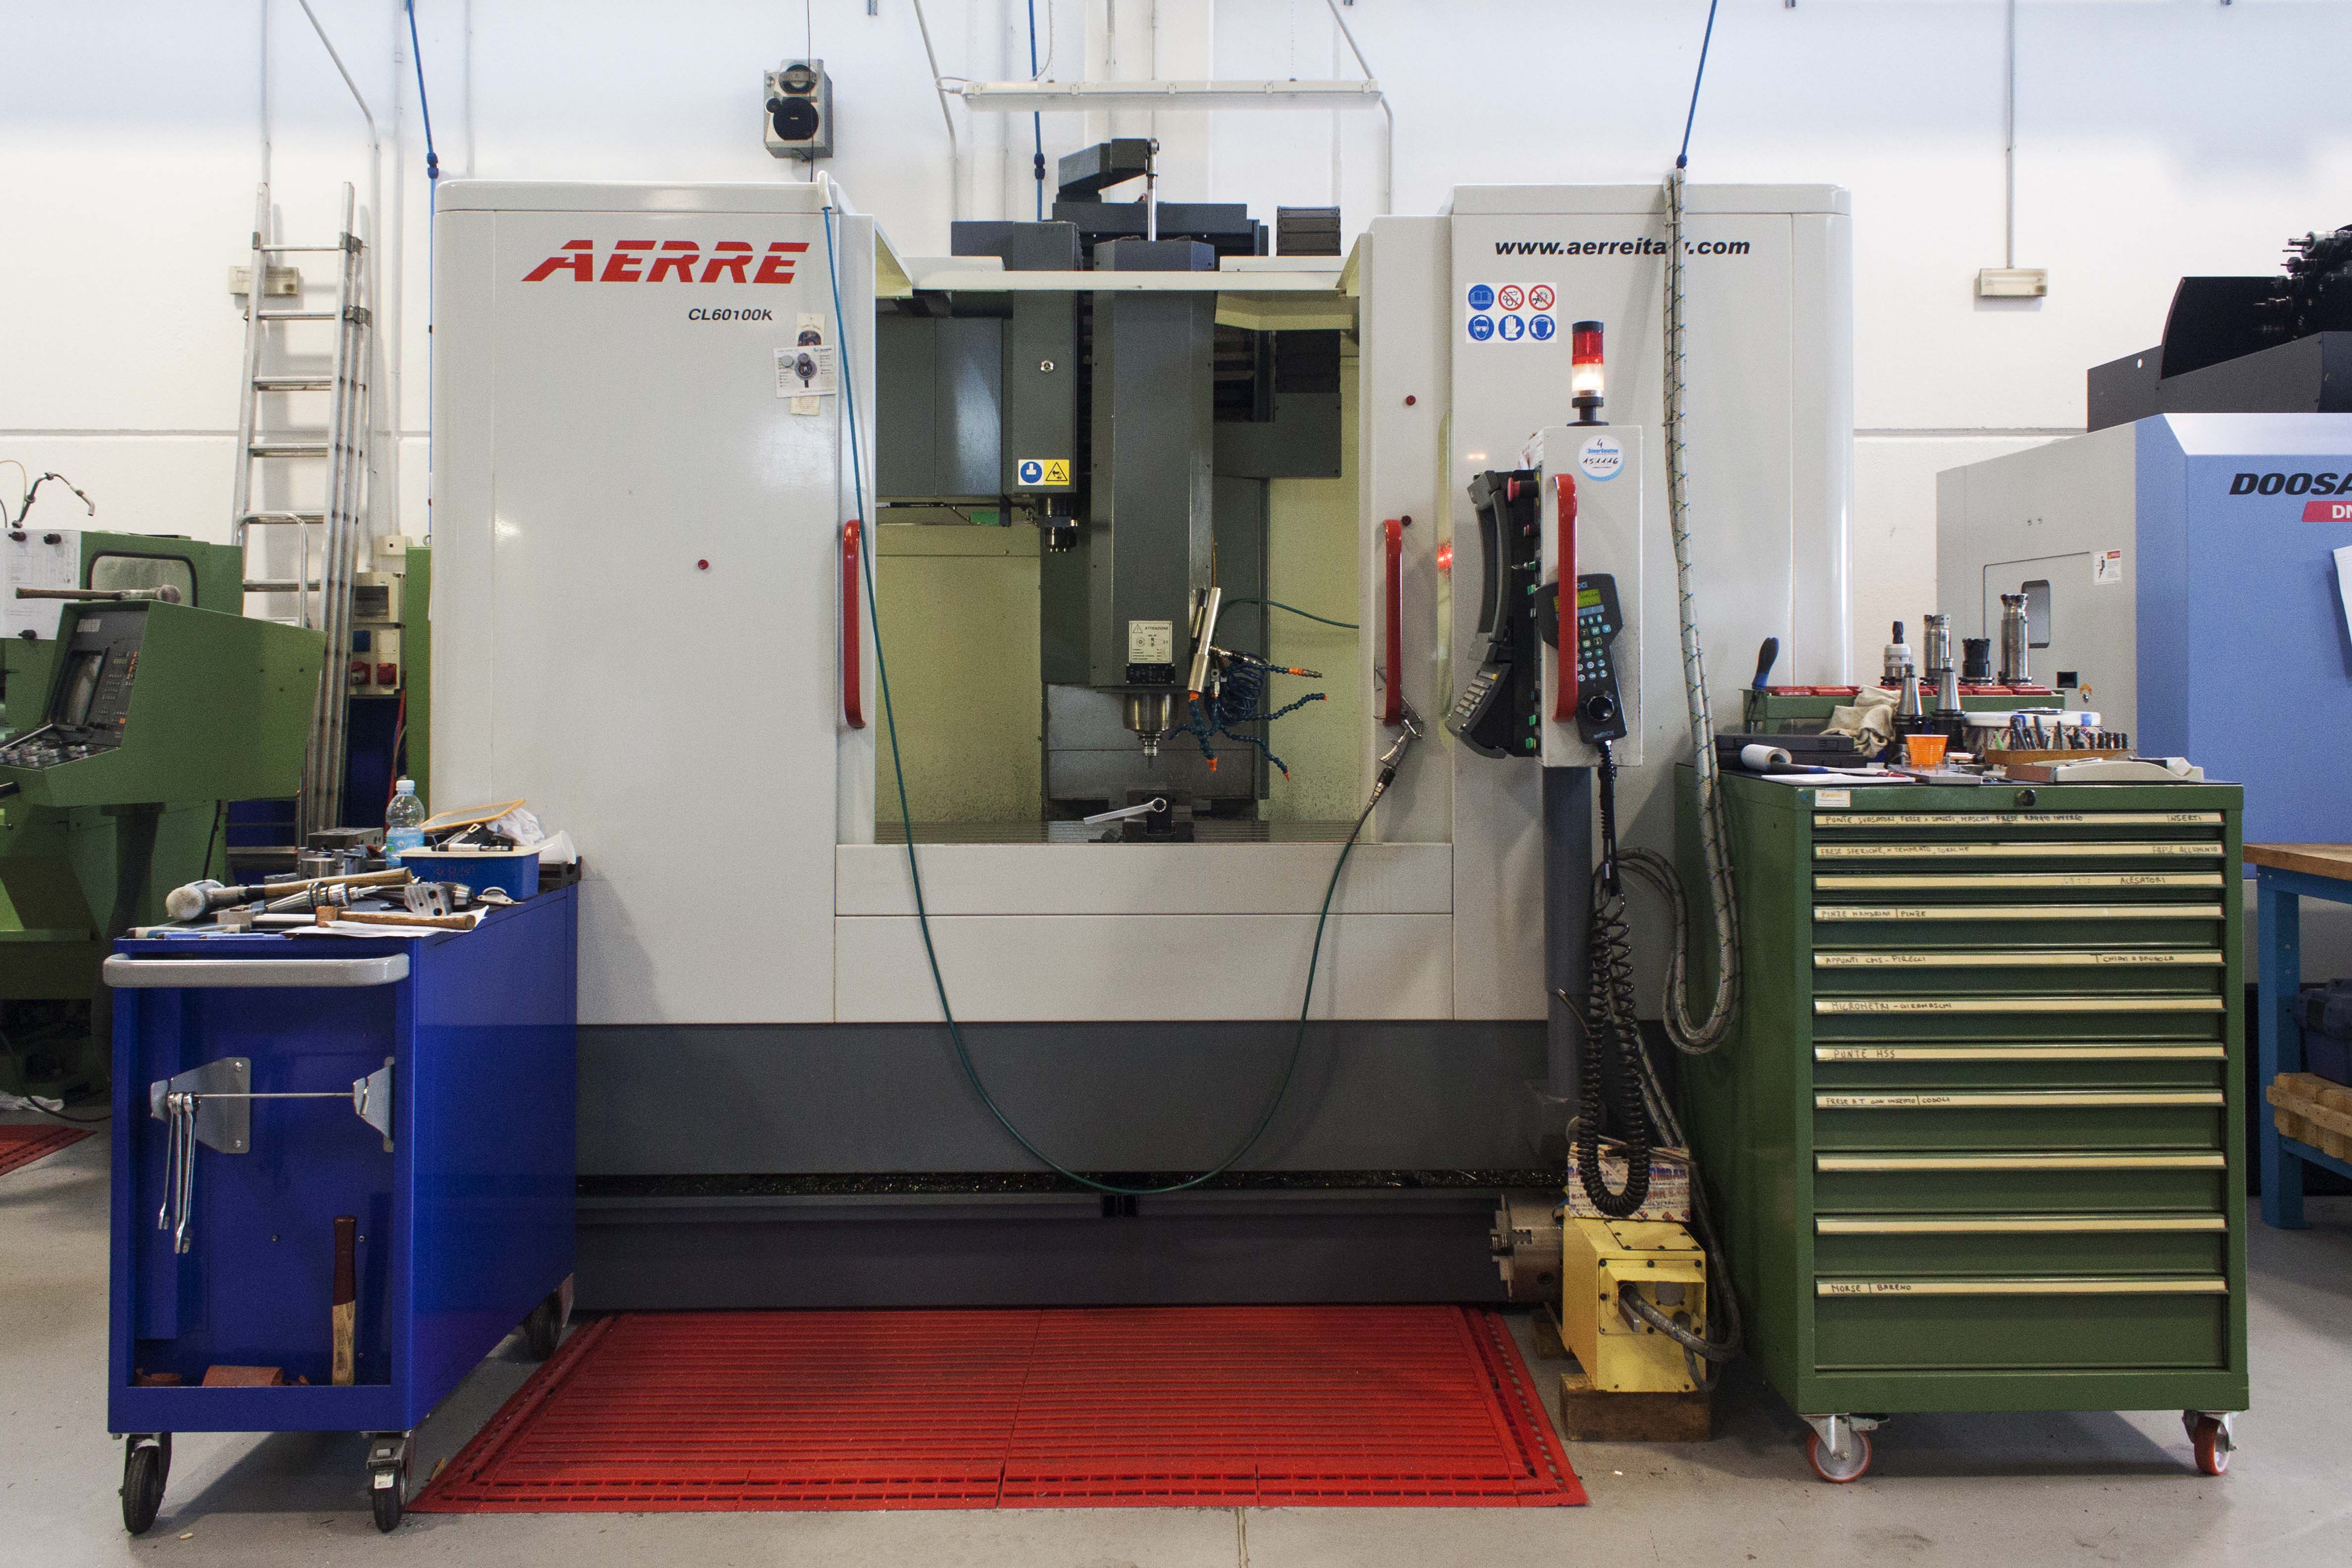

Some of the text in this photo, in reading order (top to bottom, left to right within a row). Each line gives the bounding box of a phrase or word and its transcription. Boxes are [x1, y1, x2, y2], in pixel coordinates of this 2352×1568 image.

[1495, 237, 1750, 255] www.aerreita.com
[521, 240, 810, 284] AERRE
[688, 308, 773, 321] CL60100K
[1597, 439, 1603, 448] 4
[2229, 472, 2352, 495] DOOSA
[1833, 1050, 1895, 1058] PUNTE HSS
[1831, 1284, 1862, 1293] MORSE
